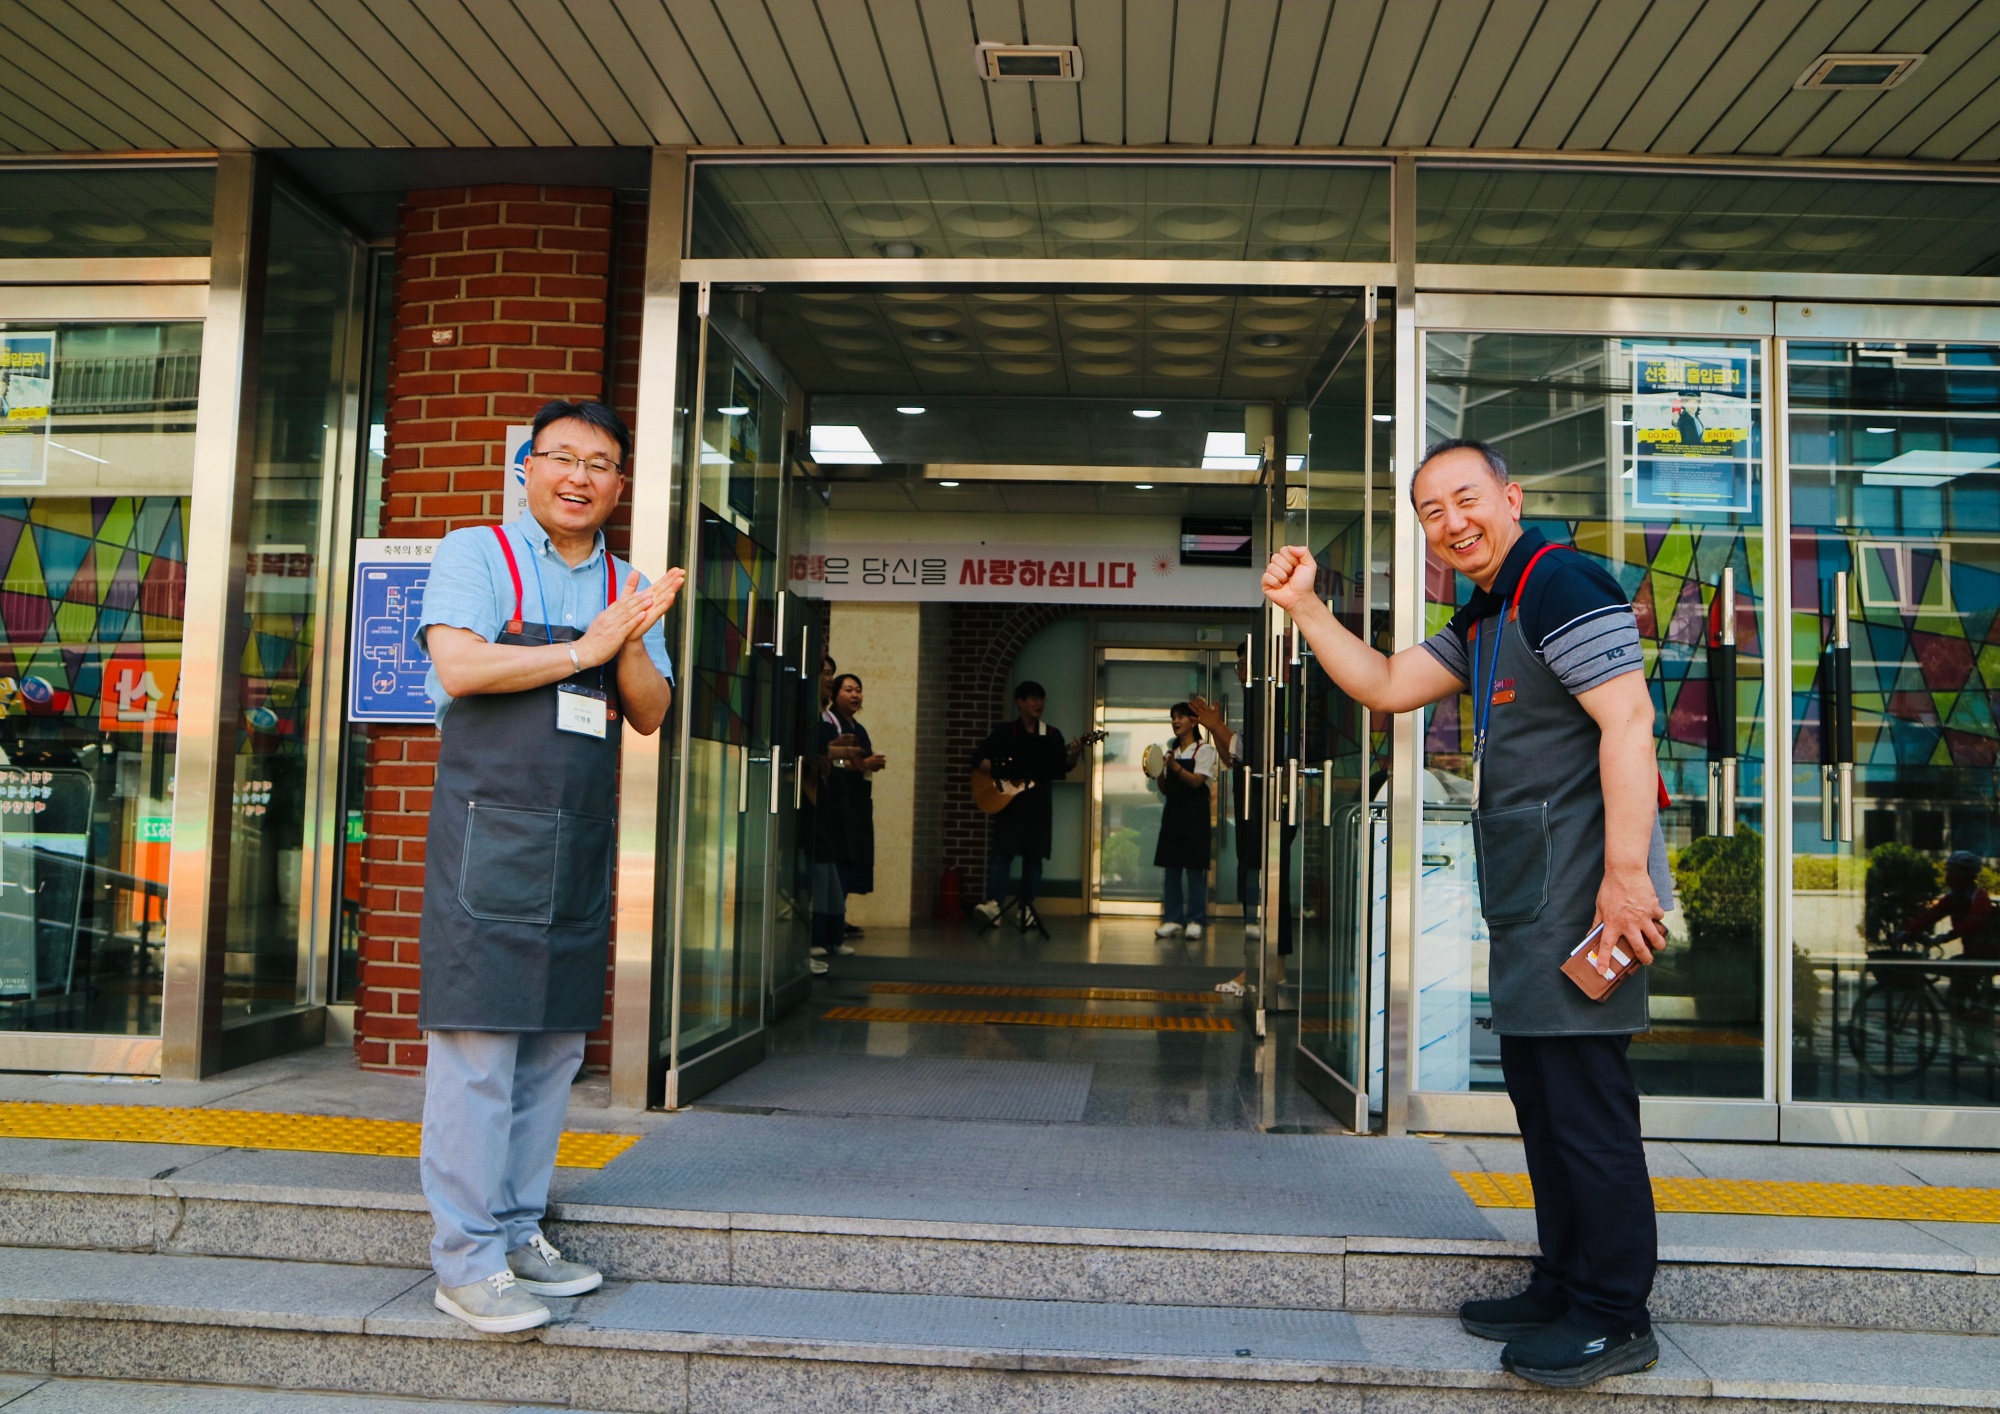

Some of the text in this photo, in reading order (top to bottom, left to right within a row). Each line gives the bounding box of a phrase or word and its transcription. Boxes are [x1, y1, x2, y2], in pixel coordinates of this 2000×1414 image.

[1645, 366, 1740, 385] 신천지 출입금지
[1707, 431, 1735, 439] ENTER
[384, 545, 432, 555] 축복의 통로
[862, 558, 947, 585] 당신을
[959, 558, 1136, 589] 사랑하십니다
[1606, 648, 1626, 661] K2
